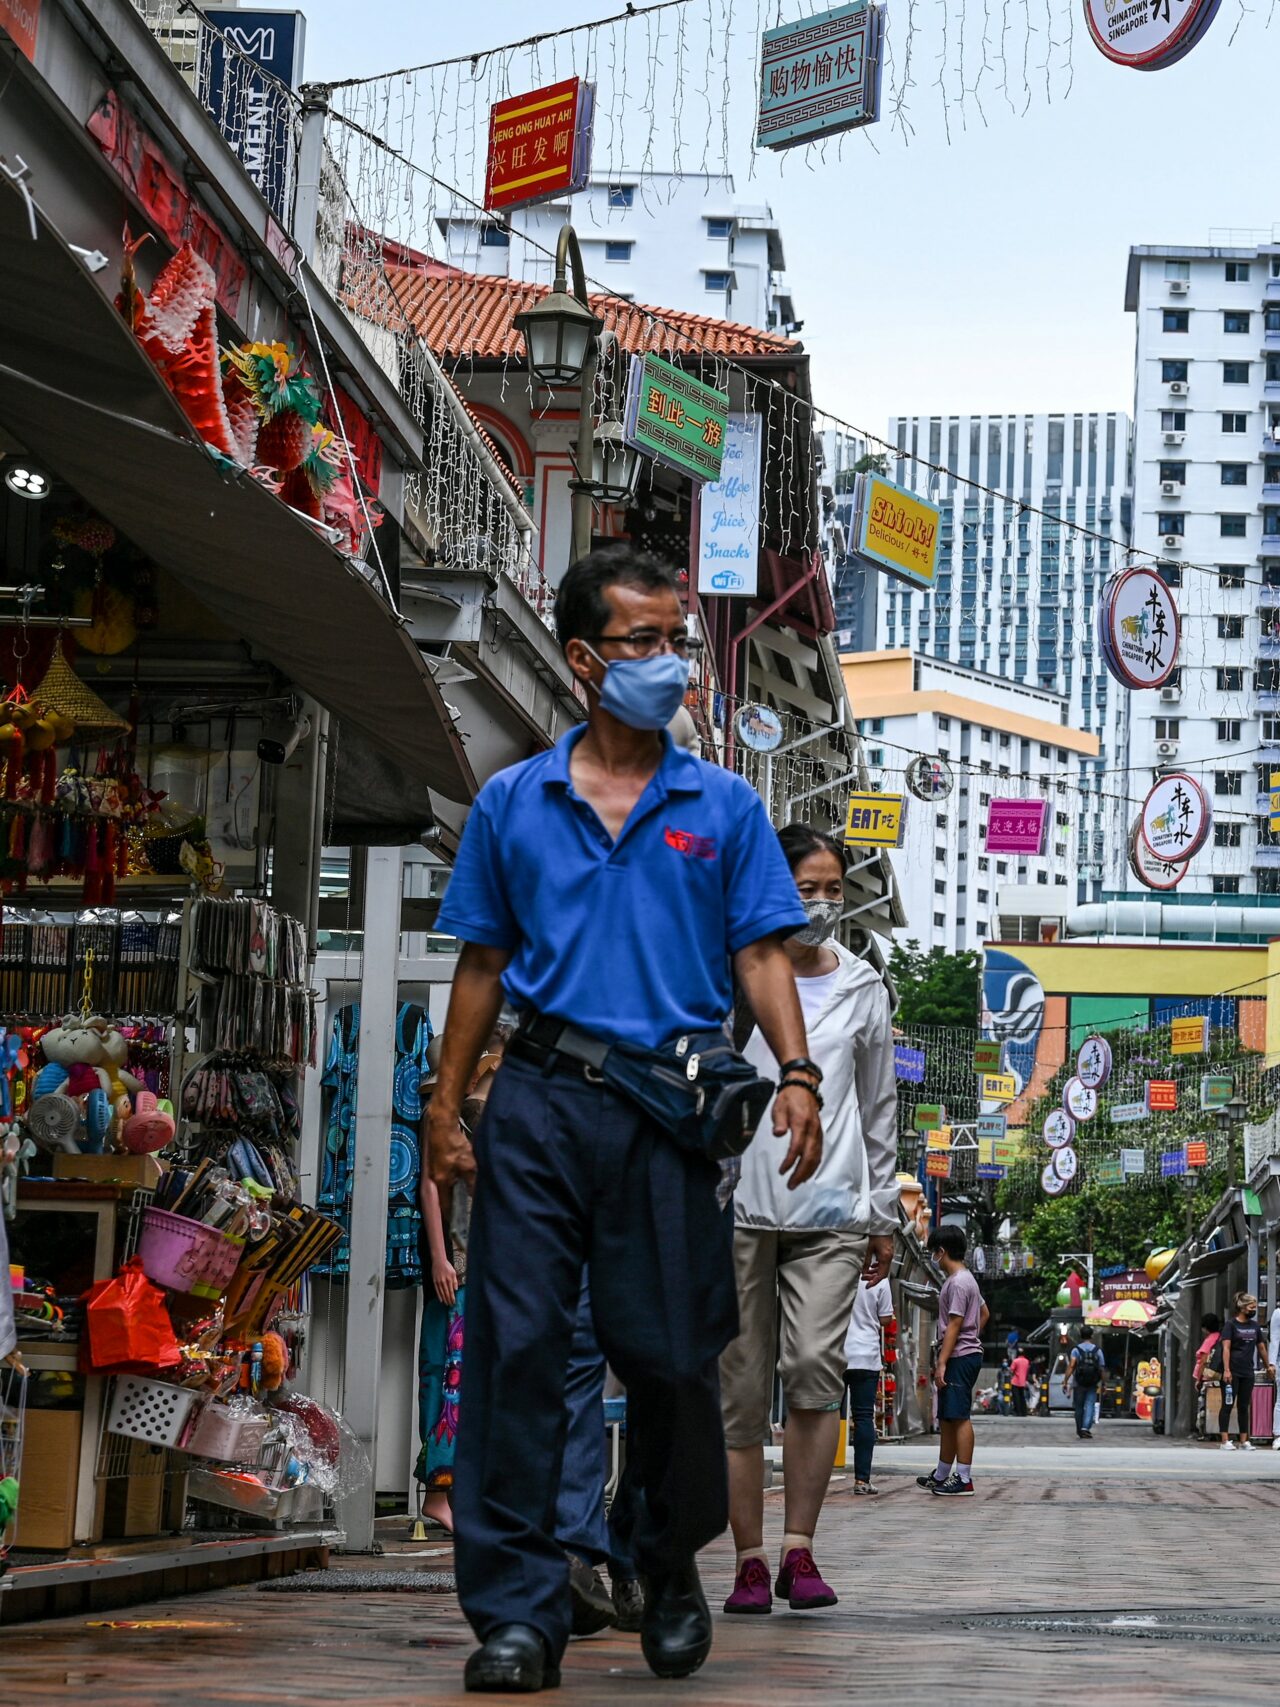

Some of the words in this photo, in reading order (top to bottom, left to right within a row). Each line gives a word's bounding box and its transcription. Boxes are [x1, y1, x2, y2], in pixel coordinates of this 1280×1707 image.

[1107, 1, 1148, 28] CHINATOWN
[1108, 12, 1148, 42] SINGAPORE
[768, 44, 856, 102] 购物愉快
[494, 127, 514, 143] HENG
[515, 121, 533, 136] ONG
[534, 111, 557, 131] HUAT
[557, 108, 573, 123] AH!
[493, 129, 570, 175] 兴旺发啊
[647, 387, 722, 449] 到此一游
[709, 476, 750, 498] Coffee
[711, 511, 745, 532] Juice
[871, 496, 935, 549] Shiok!
[704, 542, 750, 559] Snacks
[869, 523, 905, 550] Delicious
[912, 548, 929, 564] 好吃
[1121, 649, 1144, 663] SINGAPORE
[1122, 640, 1145, 656] CHINATOWN
[850, 808, 882, 830] EAT
[882, 813, 895, 829] 吃
[991, 819, 1038, 835] 欢迎光临
[1152, 832, 1173, 842] CHINATOWN
[1152, 839, 1173, 848] SINGAPORE
[985, 1079, 1004, 1093] EAT
[1104, 1283, 1131, 1291] STREET
